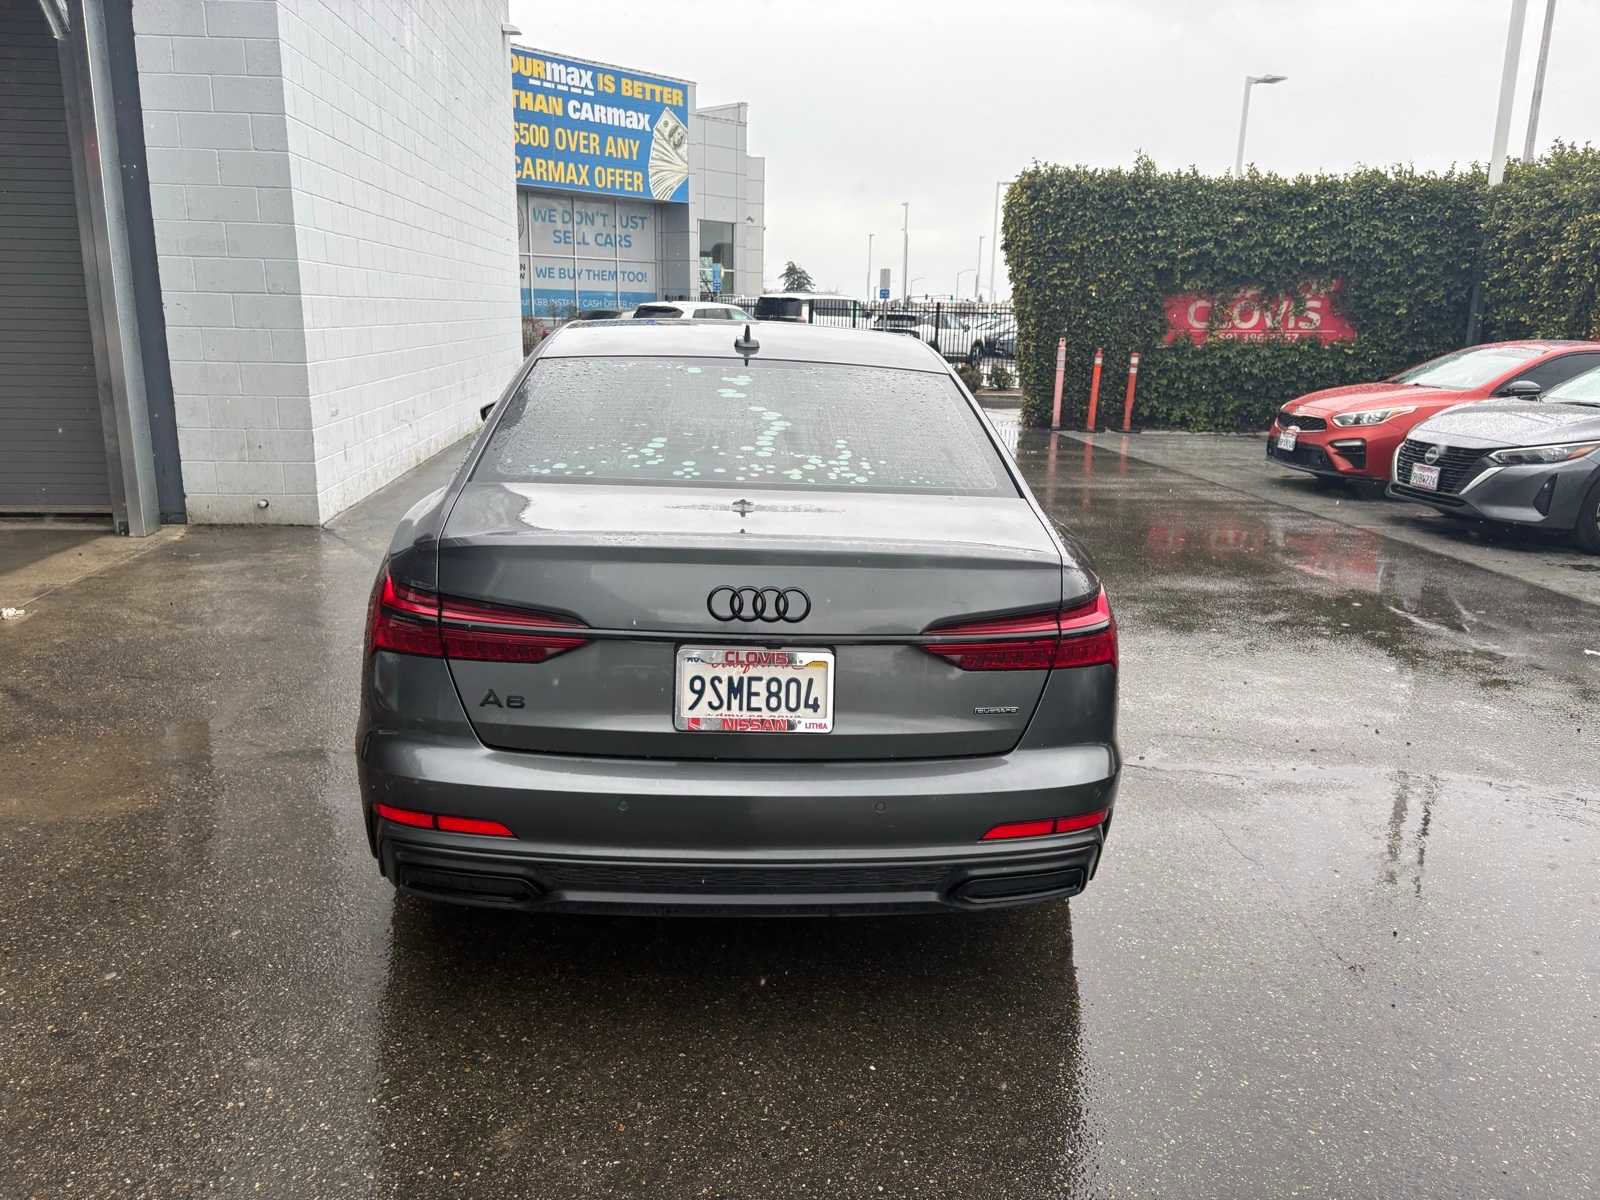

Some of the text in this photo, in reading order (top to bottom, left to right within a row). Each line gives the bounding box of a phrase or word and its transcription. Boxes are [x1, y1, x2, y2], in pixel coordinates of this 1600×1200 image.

[597, 73, 615, 93] IS
[621, 78, 683, 106] BETTER
[512, 90, 651, 132] THAN CARmax
[513, 121, 640, 160] $500 OVER ANY
[514, 155, 644, 192] CARMAX OFFER
[533, 208, 557, 223] WE
[612, 215, 648, 230] UST
[595, 233, 632, 248] CARS
[535, 267, 555, 279] WE
[558, 268, 583, 280] BUY
[585, 269, 618, 281] THEM
[620, 270, 648, 283] TOO!
[1187, 299, 1321, 329] COVIS
[724, 651, 789, 665] CLOVIS
[480, 688, 525, 709] A6
[688, 674, 821, 713] 9SME804
[722, 718, 788, 731] NISSAN
[804, 721, 828, 730] LITHIA
